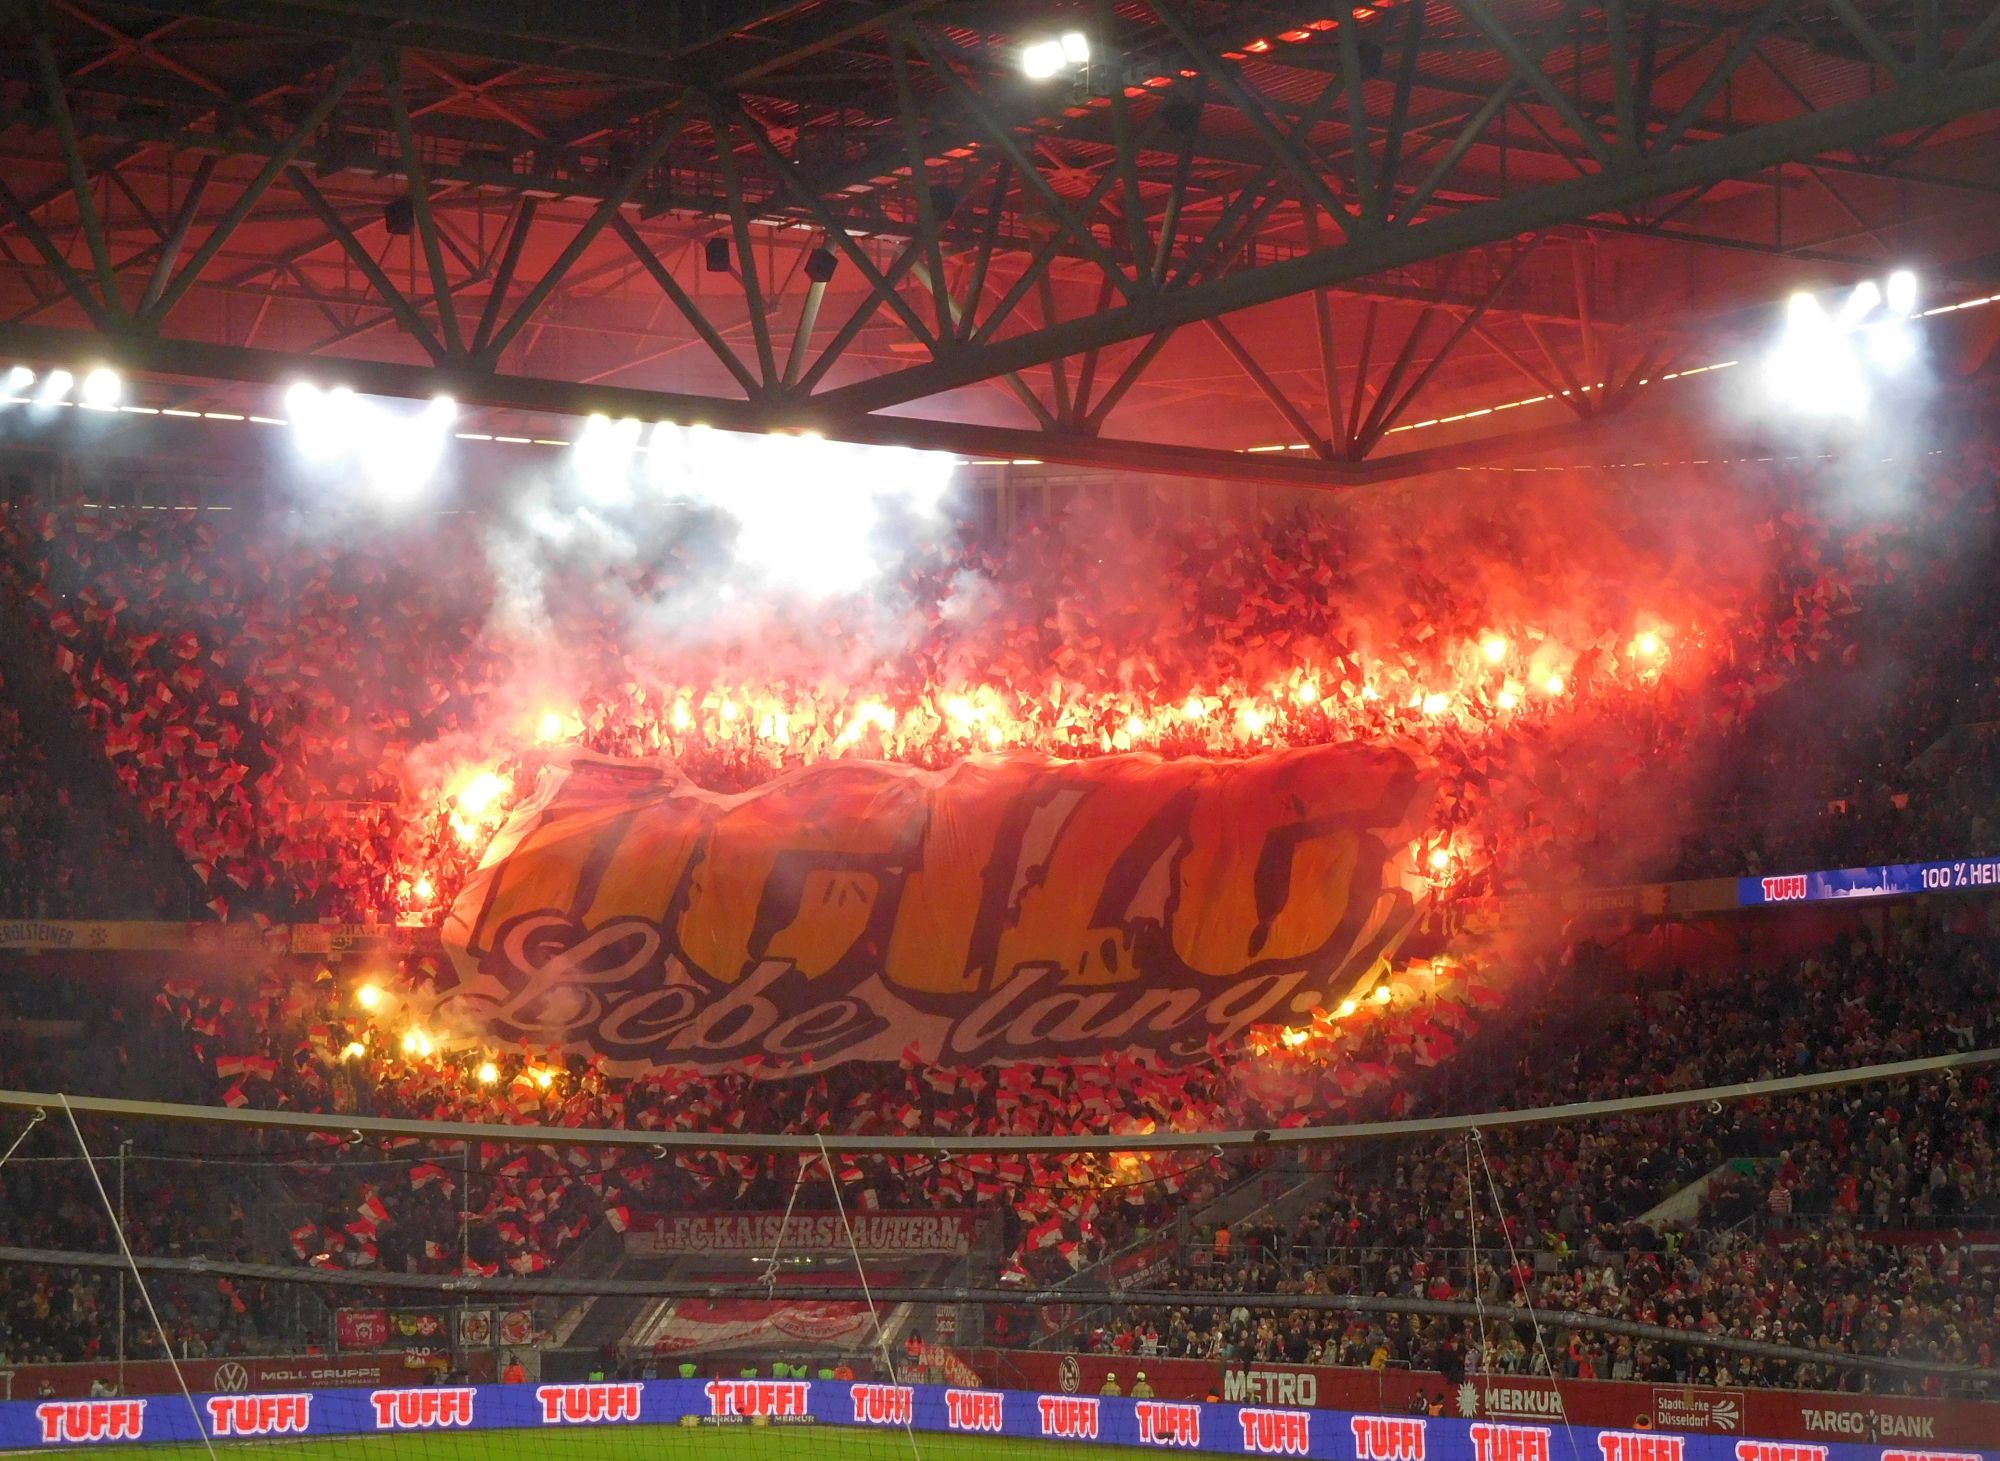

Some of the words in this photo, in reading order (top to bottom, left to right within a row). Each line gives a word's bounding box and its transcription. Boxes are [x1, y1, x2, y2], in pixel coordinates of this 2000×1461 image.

[1762, 875, 1806, 901] TUFFI
[1921, 867, 1950, 889] 100
[1954, 862, 1968, 886] %
[1970, 861, 2000, 885] HEI
[436, 914, 866, 1058] Lebe
[261, 1370, 307, 1381] MOLL
[311, 1368, 381, 1379] GRUPPE
[1224, 1370, 1317, 1407] METRO
[207, 1393, 313, 1435] TUFFI
[370, 1388, 474, 1428] TUFFI
[536, 1384, 642, 1424] TUFFI
[705, 1380, 810, 1418] TUFFI
[774, 1415, 816, 1423] MERKUR
[851, 1384, 914, 1425] TUFFI
[945, 1389, 1004, 1432] TUFFI
[1038, 1395, 1100, 1439] TUFFI
[1485, 1388, 1563, 1414] MERKUR
[36, 1401, 145, 1442] TUFFI
[1135, 1401, 1200, 1447] TUFFI
[1239, 1408, 1309, 1455] TUFFI
[1351, 1415, 1426, 1461] TUFFI
[1658, 1411, 1710, 1428] Düsseldorf
[1470, 1423, 1550, 1461] TUFFI
